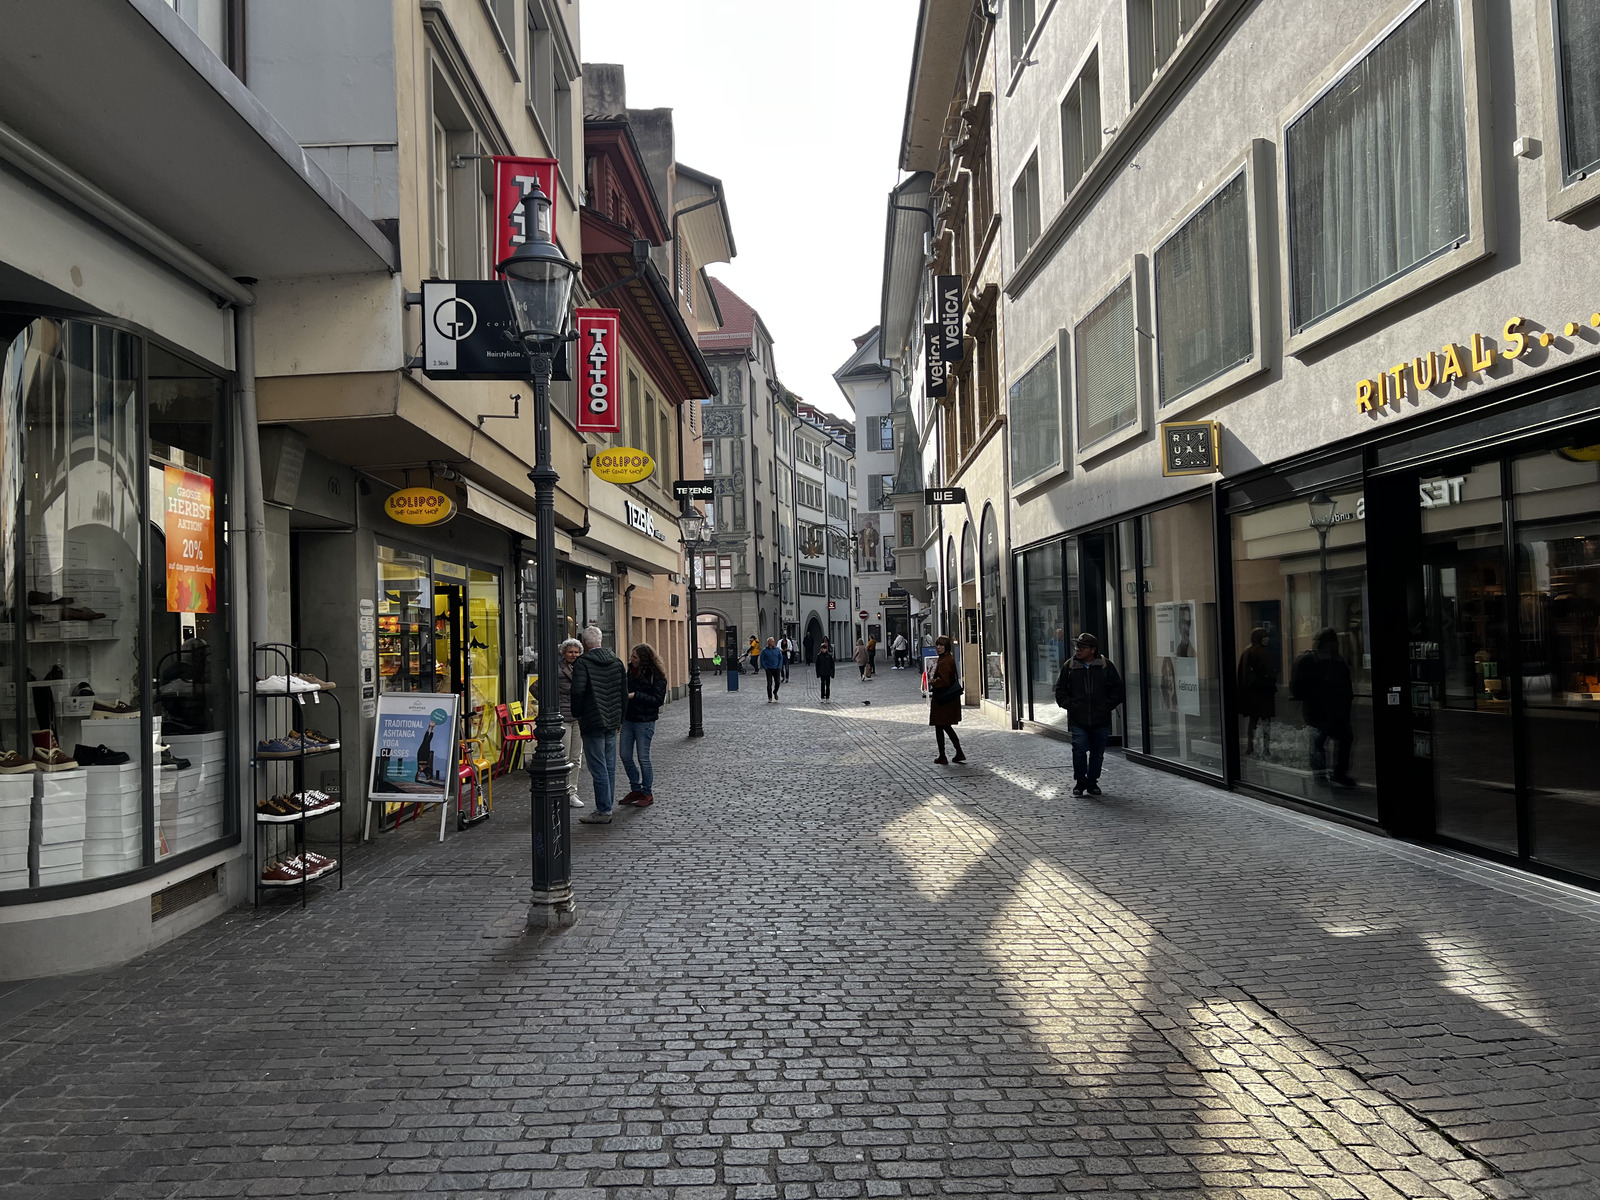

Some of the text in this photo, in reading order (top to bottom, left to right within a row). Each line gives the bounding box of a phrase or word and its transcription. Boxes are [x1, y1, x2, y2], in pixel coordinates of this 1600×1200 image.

[589, 328, 608, 412] TATTOO
[596, 455, 650, 468] LOLIPOP
[177, 486, 201, 501] GROSSE
[933, 491, 953, 501] WE
[390, 495, 445, 508] LOLIPOP
[168, 497, 211, 520] HERBST
[177, 519, 202, 531] AKTION
[183, 539, 203, 560] 20%
[384, 719, 424, 729] TRADITIONAL
[382, 730, 416, 738] ASHTANGA
[381, 749, 410, 758] CLASSES
